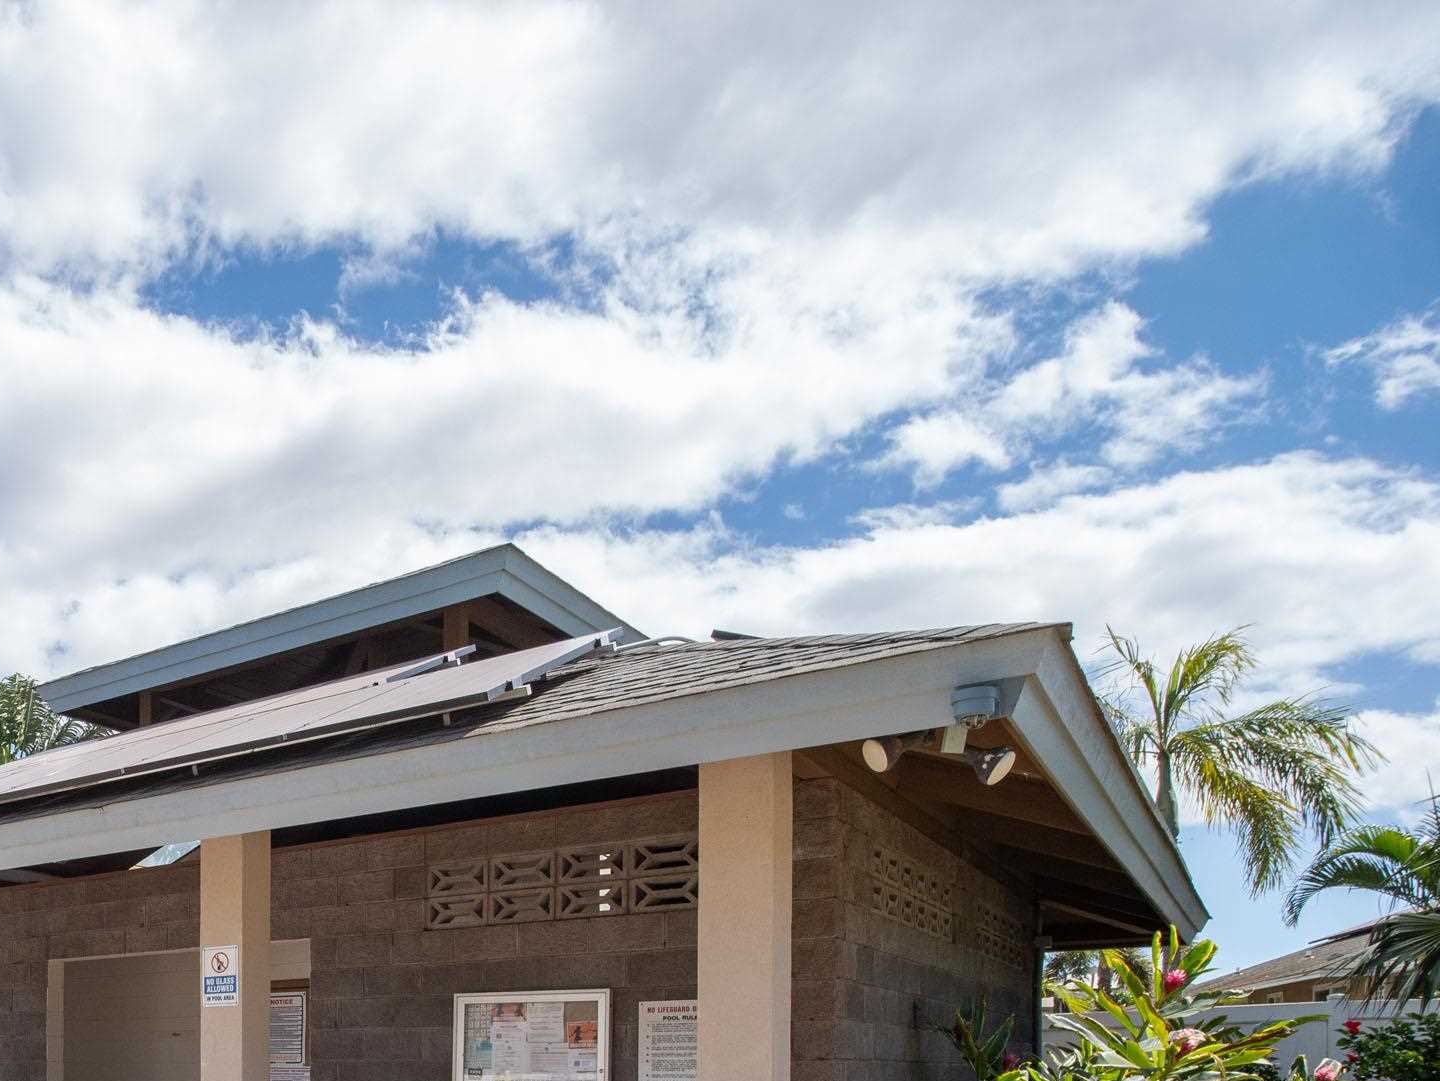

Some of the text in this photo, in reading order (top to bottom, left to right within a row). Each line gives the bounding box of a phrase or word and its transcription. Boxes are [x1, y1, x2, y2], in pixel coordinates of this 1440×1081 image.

[206, 977, 235, 986] NO GLASS
[206, 984, 234, 992] ALLOWED
